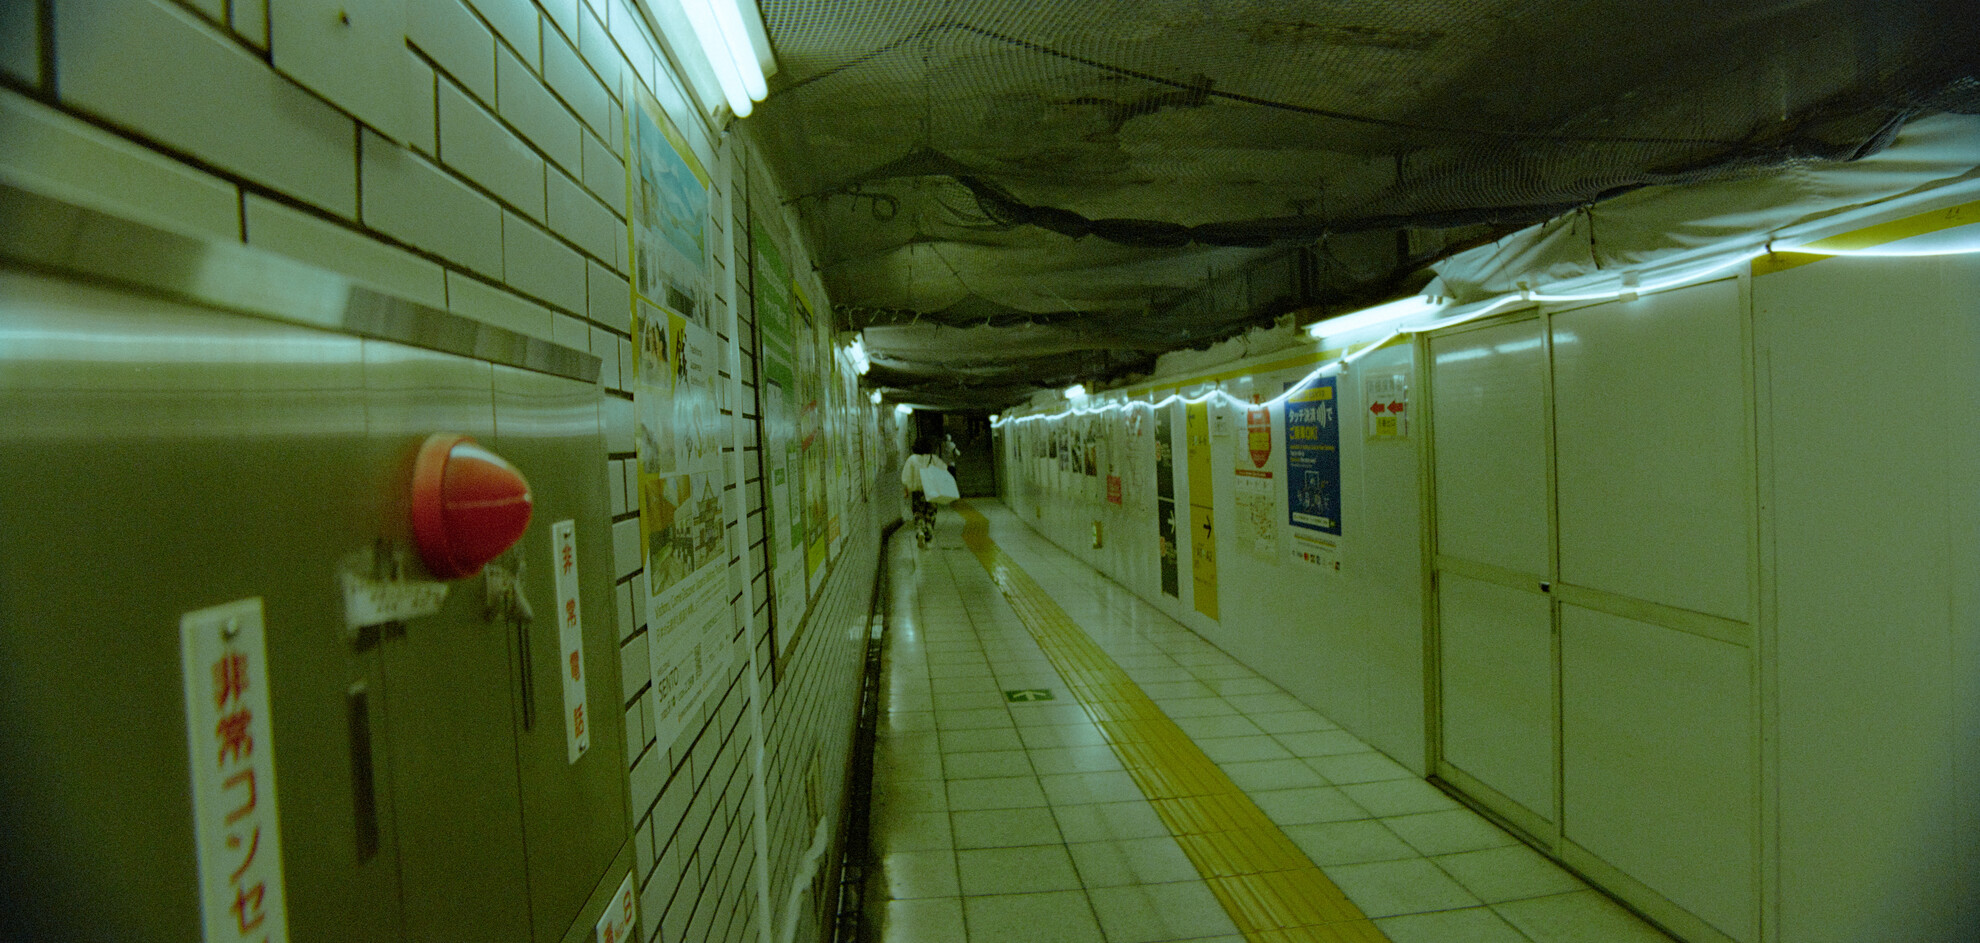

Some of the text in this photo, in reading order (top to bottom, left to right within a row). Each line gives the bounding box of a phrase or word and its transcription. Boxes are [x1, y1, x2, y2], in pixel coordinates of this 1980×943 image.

[562, 544, 584, 740] 非常電話
[212, 653, 269, 943] 非常コンセ
